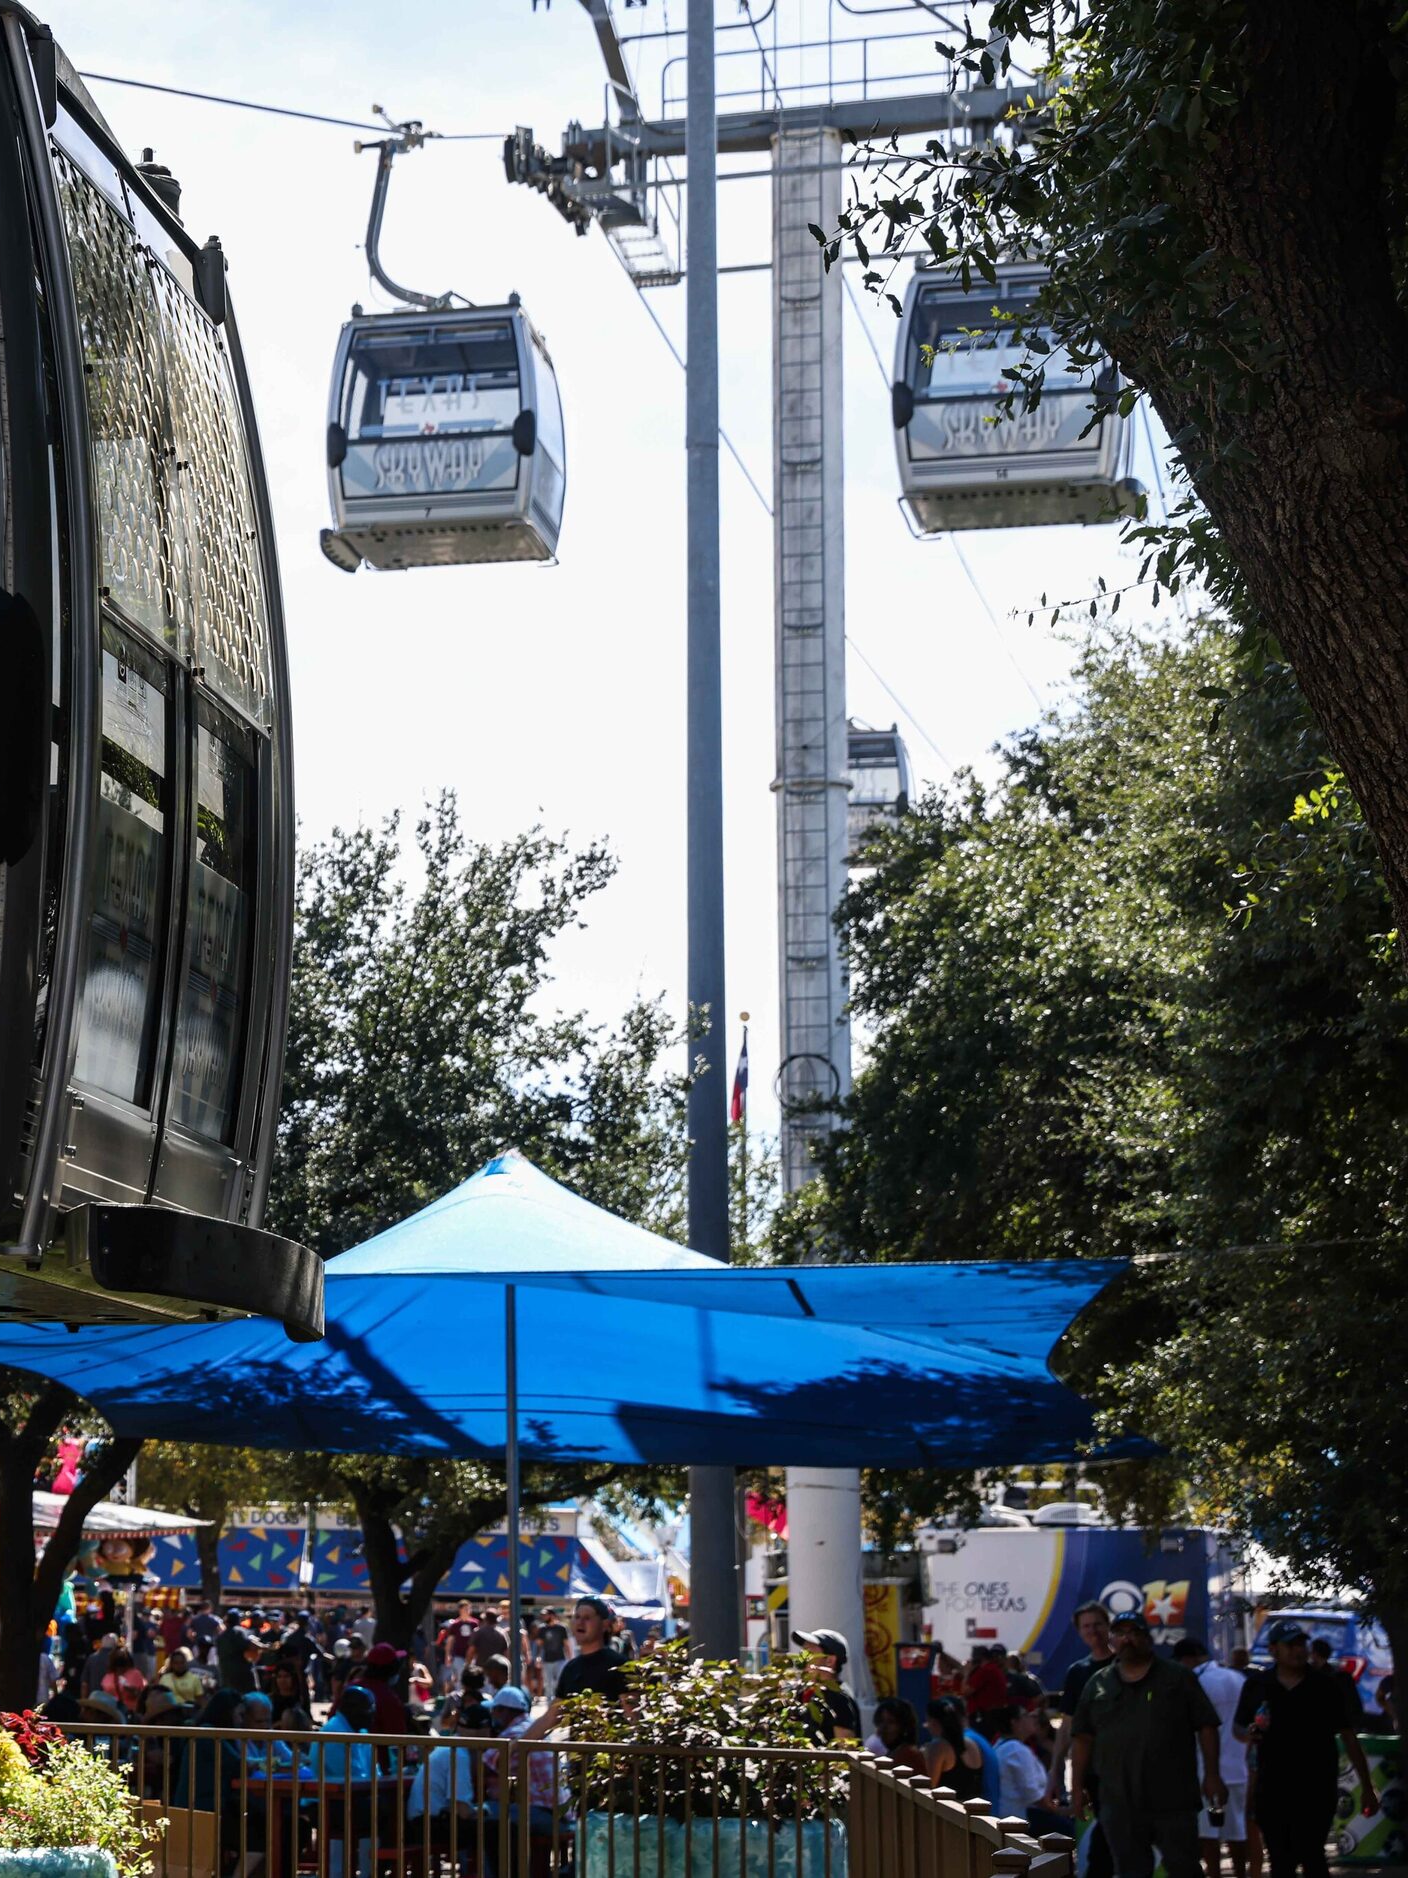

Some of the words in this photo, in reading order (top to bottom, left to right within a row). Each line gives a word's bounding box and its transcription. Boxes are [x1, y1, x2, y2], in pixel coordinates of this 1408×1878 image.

[377, 374, 481, 416] TEXAS
[943, 397, 1062, 451] SKYWAY
[375, 439, 484, 489] SKYWAY
[424, 506, 432, 518] 7
[935, 1582, 960, 1596] THE
[964, 1581, 1010, 1597] ONES
[946, 1597, 975, 1612] FOR
[981, 1597, 1027, 1613] TEXAS
[1142, 1580, 1191, 1627] 11
